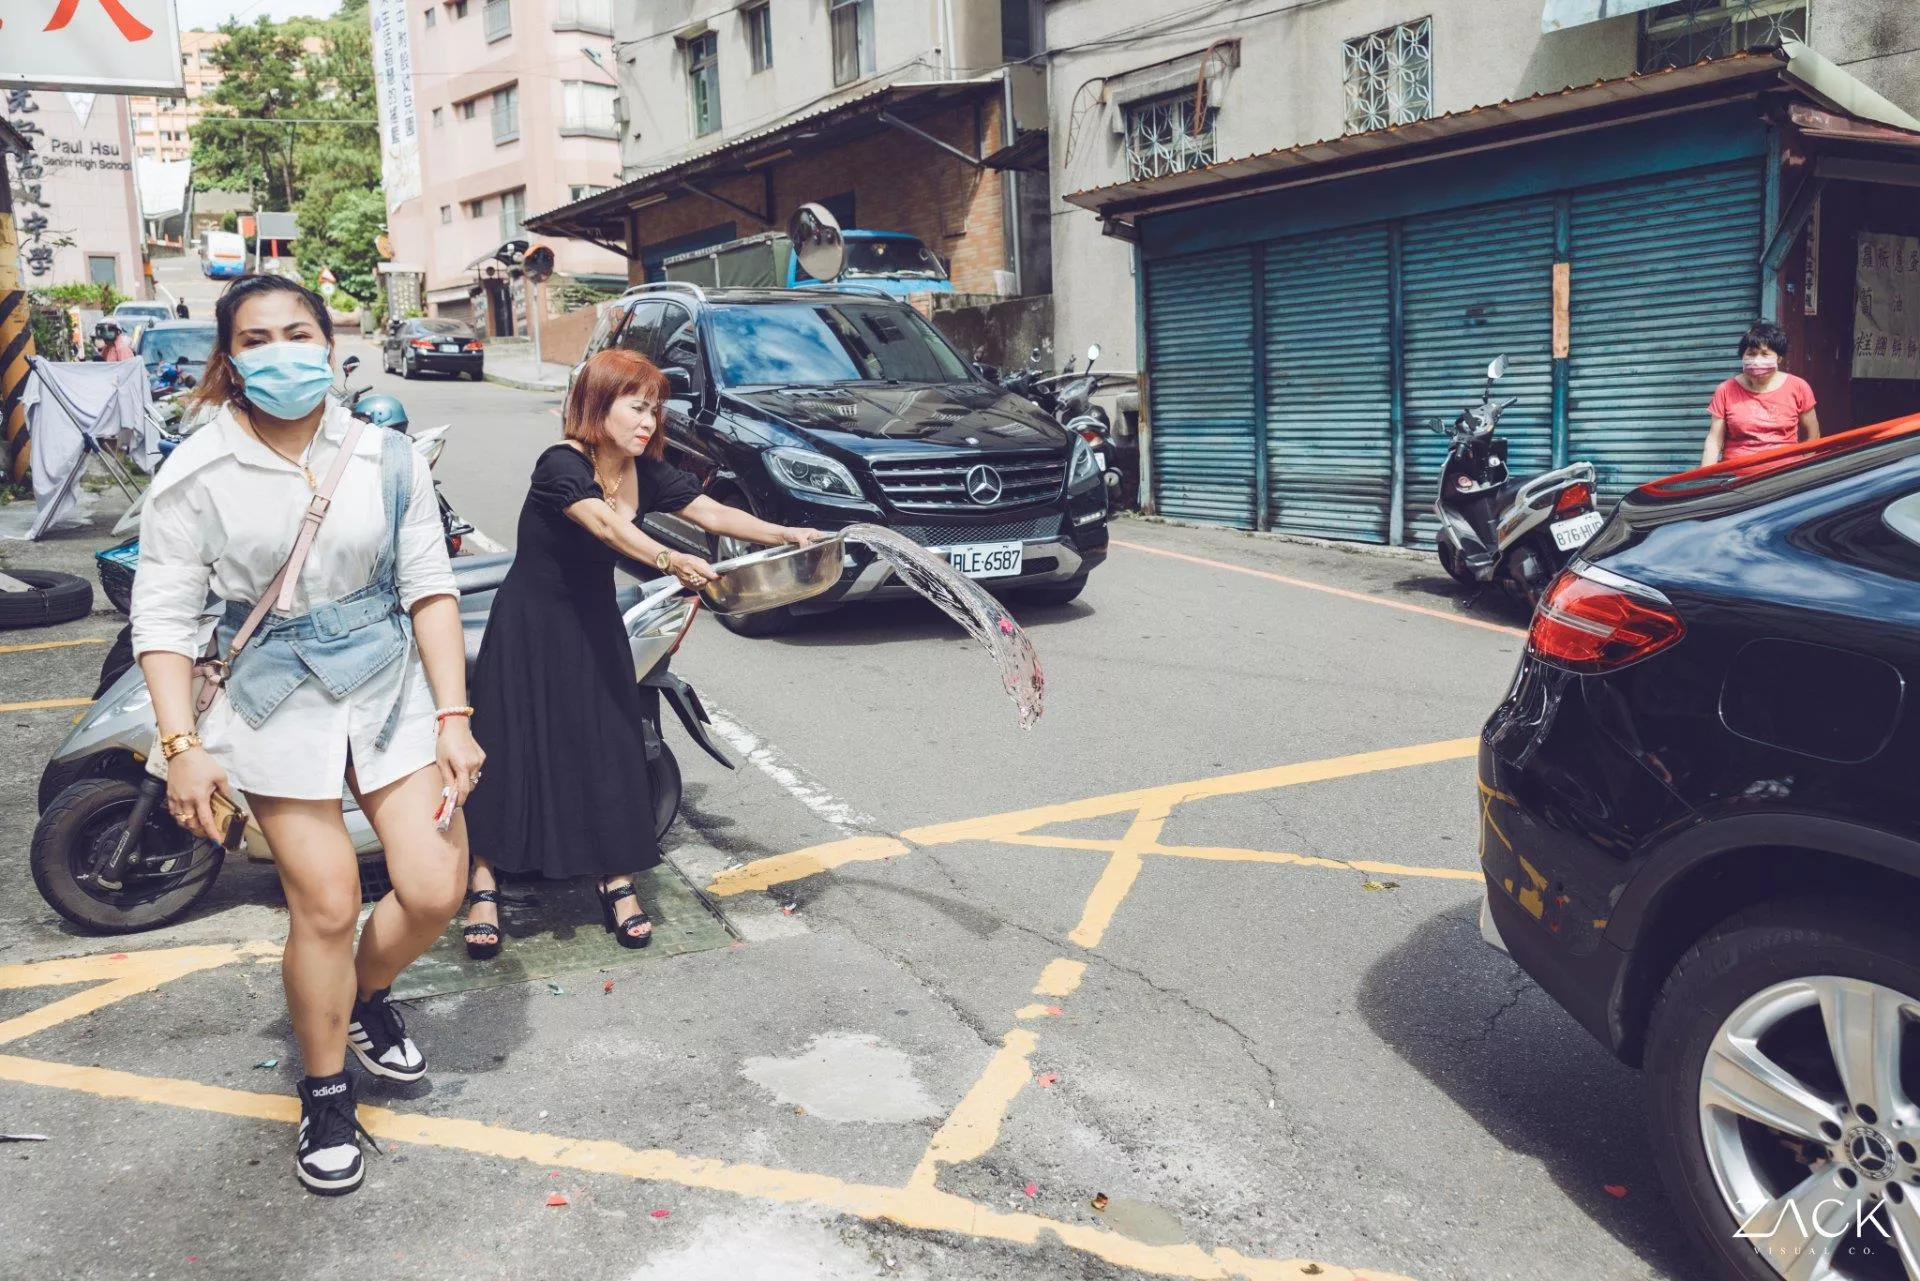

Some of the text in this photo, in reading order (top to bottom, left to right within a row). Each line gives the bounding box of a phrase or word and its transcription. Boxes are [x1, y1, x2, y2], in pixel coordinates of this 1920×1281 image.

[51, 138, 120, 156] Paul Hsu
[42, 155, 133, 171] Senior High School
[312, 1083, 347, 1097] adidas
